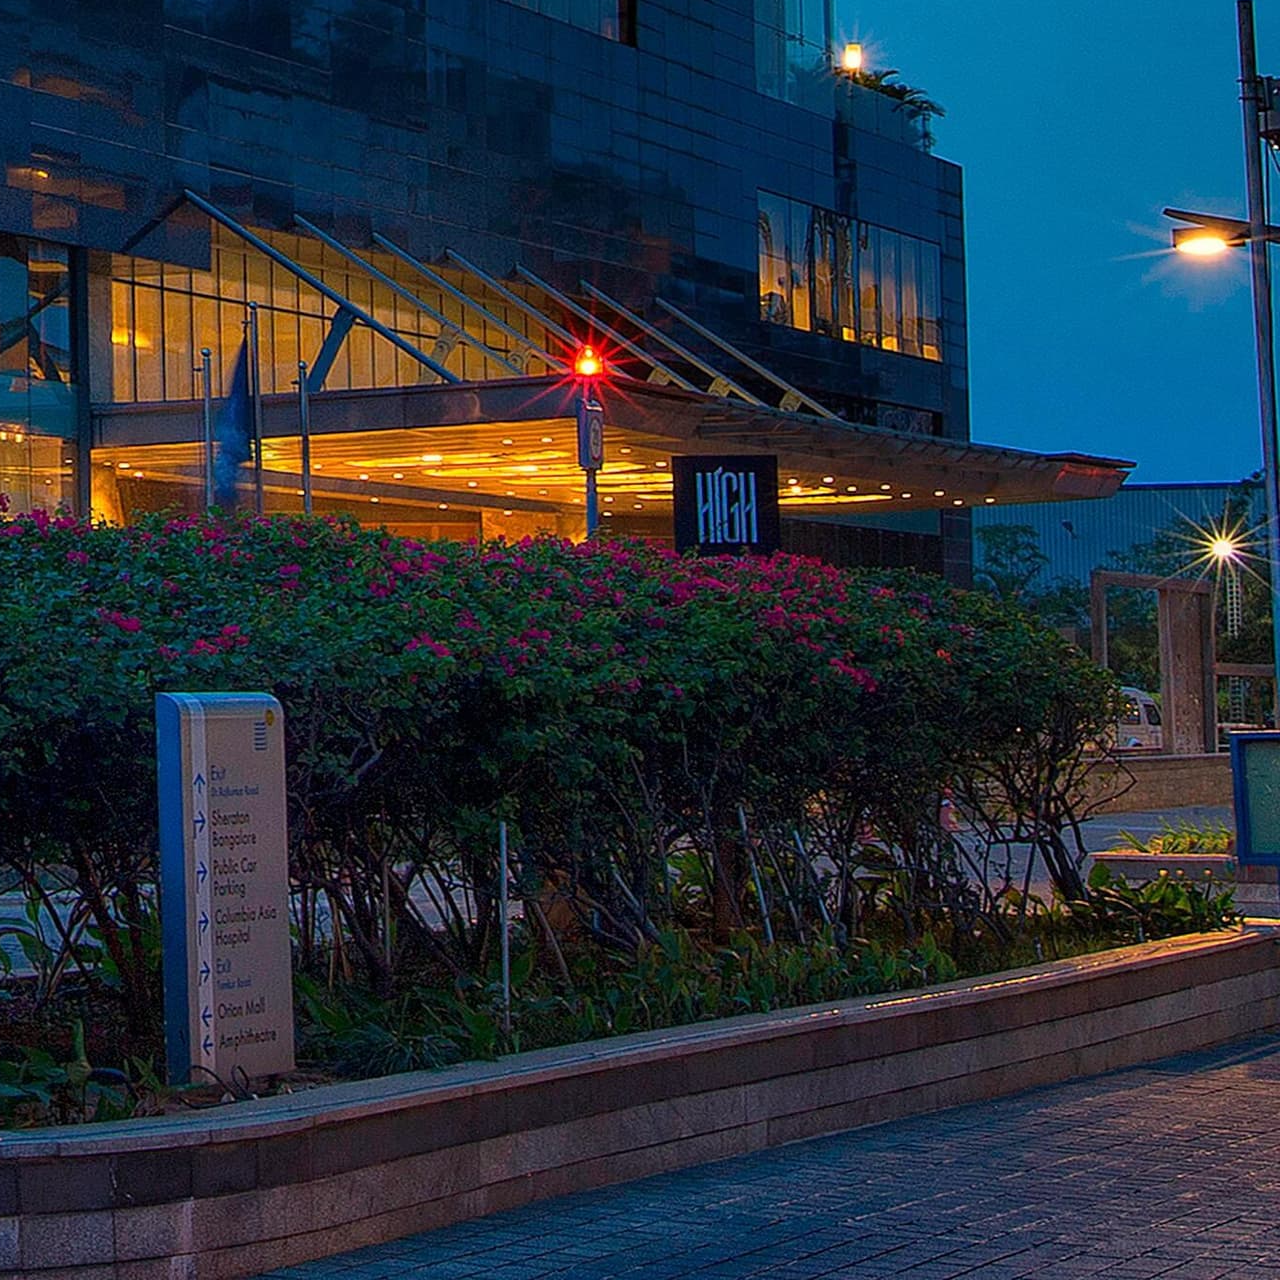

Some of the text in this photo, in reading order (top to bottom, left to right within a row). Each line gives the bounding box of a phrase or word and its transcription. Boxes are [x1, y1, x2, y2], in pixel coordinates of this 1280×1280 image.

[696, 467, 758, 544] HIGH
[211, 809, 250, 826] Sheraton
[212, 829, 257, 851] Bangalore
[213, 857, 257, 876] Public Car
[214, 879, 246, 898] Parking
[215, 904, 277, 925] Columbia Asia
[215, 926, 250, 949] Hospital
[218, 996, 265, 1020] Orion Mall
